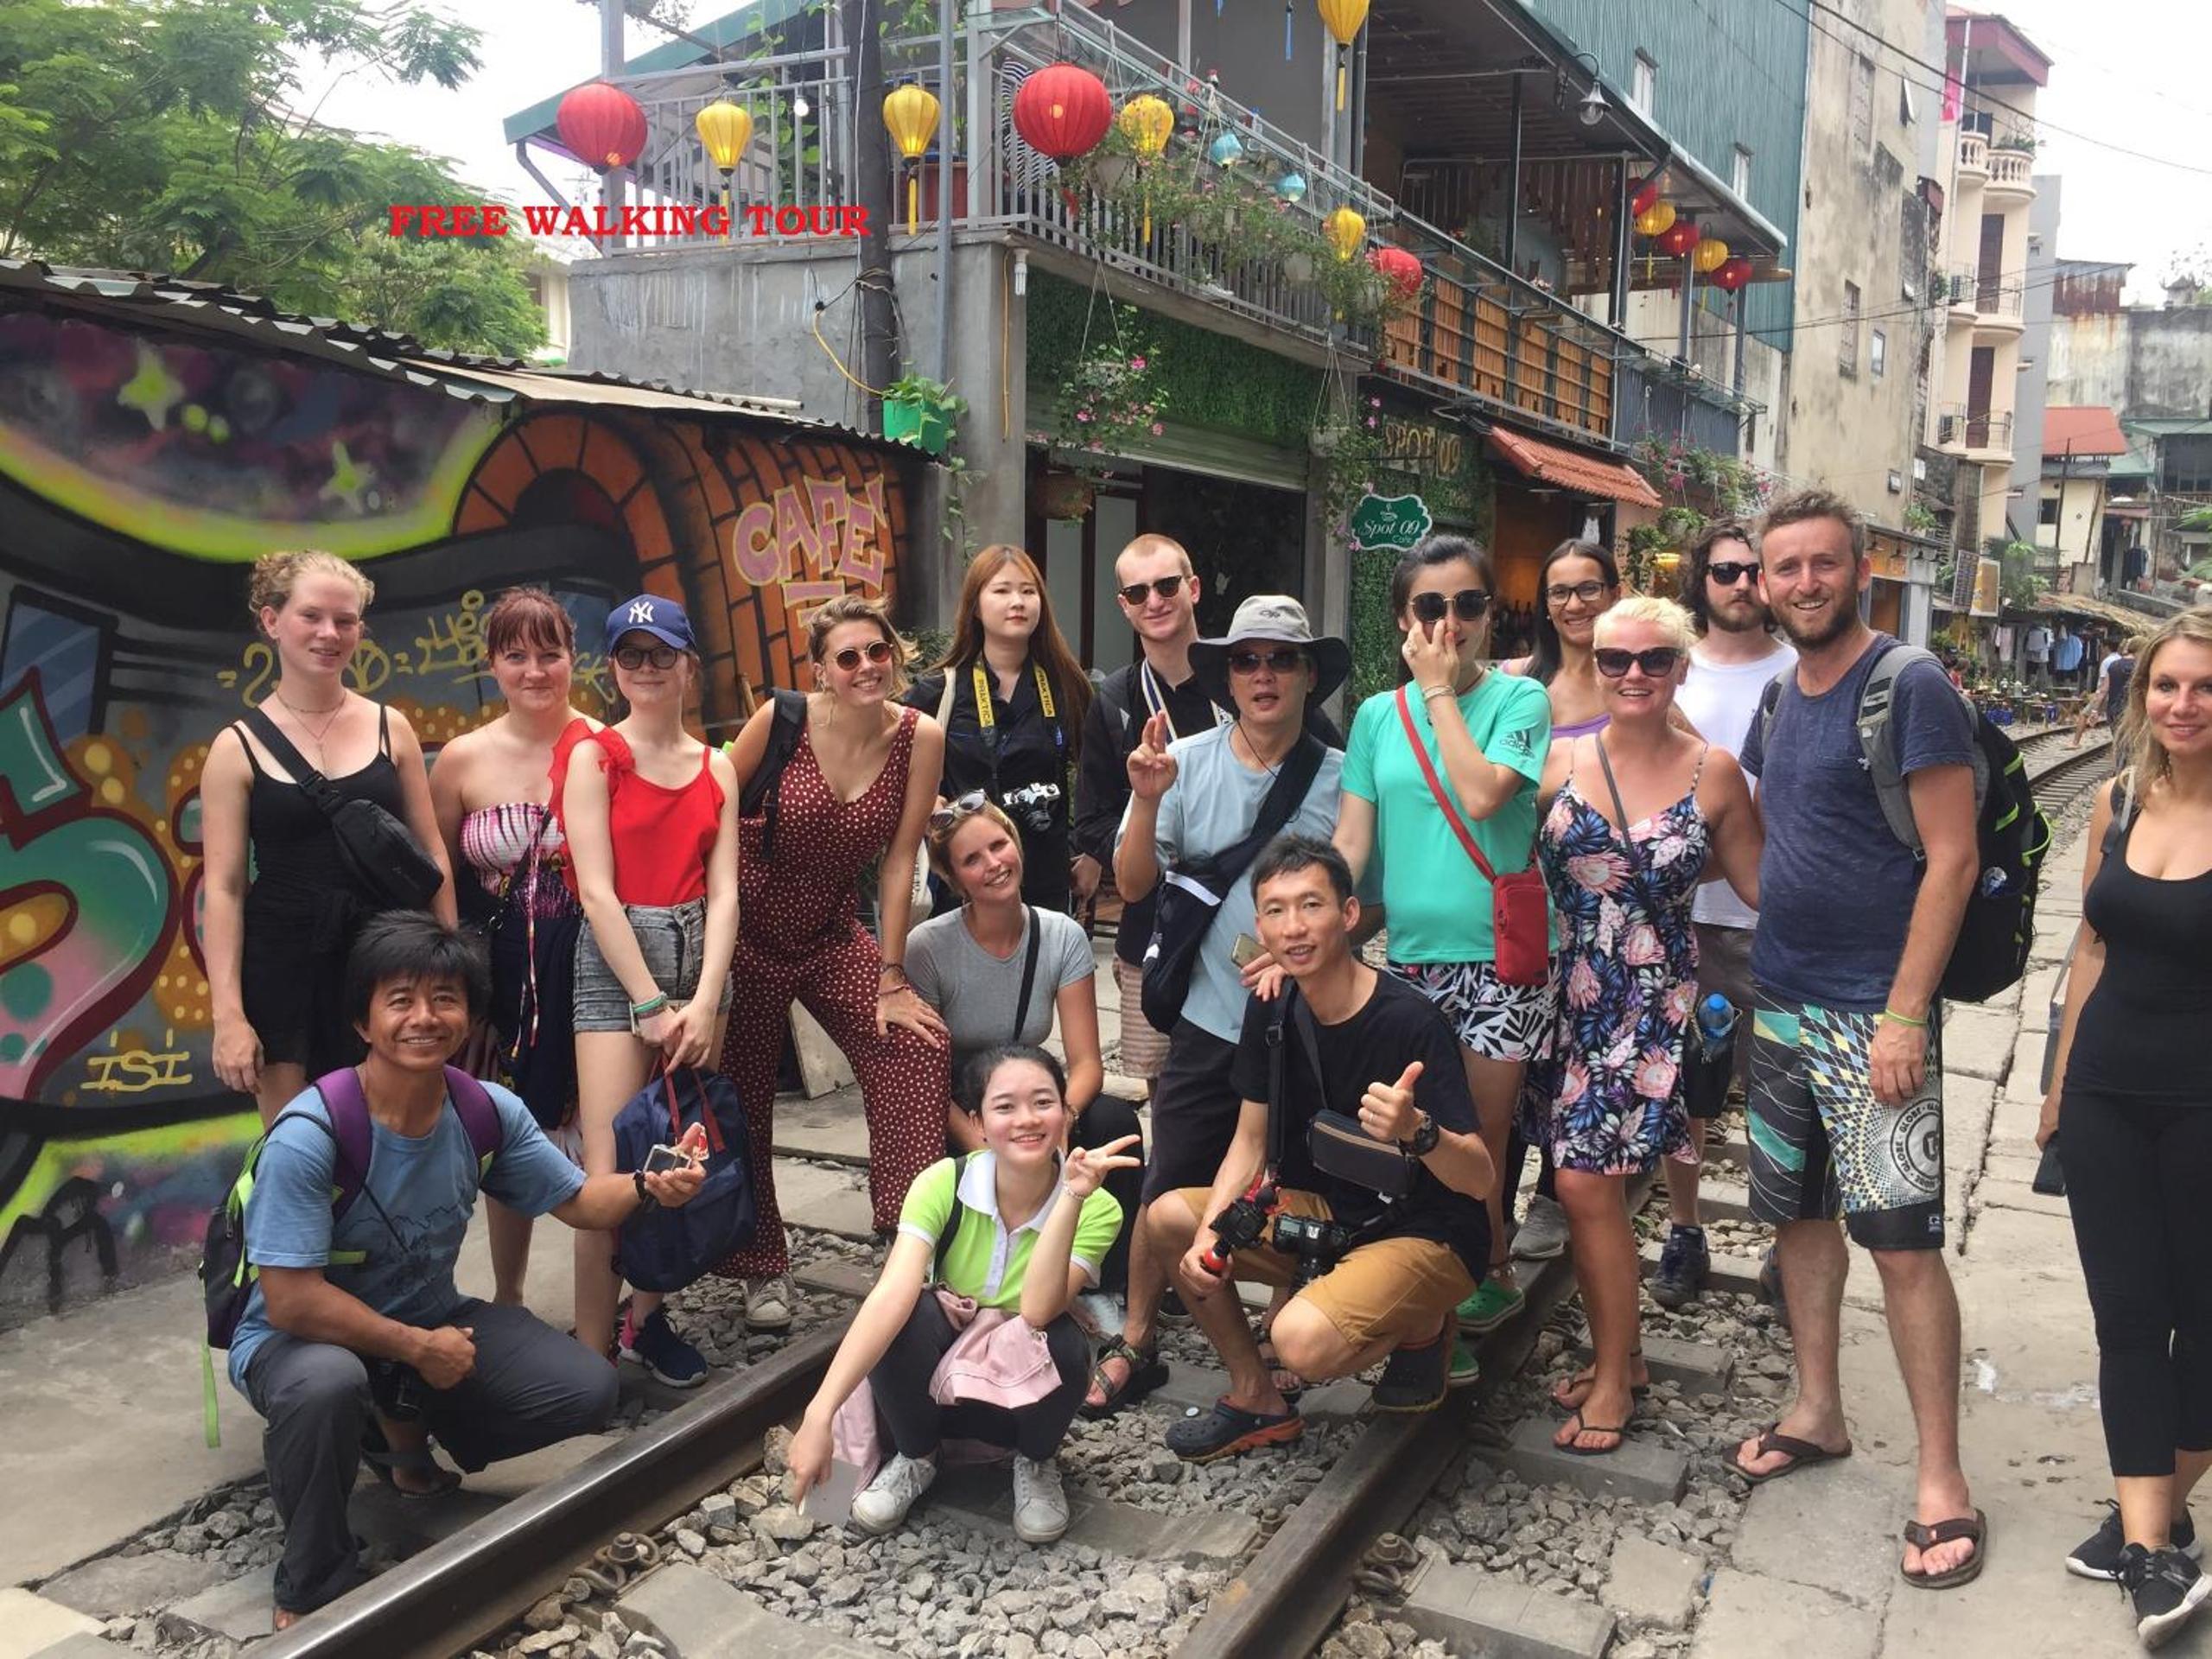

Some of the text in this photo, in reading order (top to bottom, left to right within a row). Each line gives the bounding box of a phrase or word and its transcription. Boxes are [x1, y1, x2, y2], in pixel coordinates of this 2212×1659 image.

[1384, 422, 1435, 458] SPOT
[1364, 519, 1396, 538] Spot
[628, 601, 654, 624] NY
